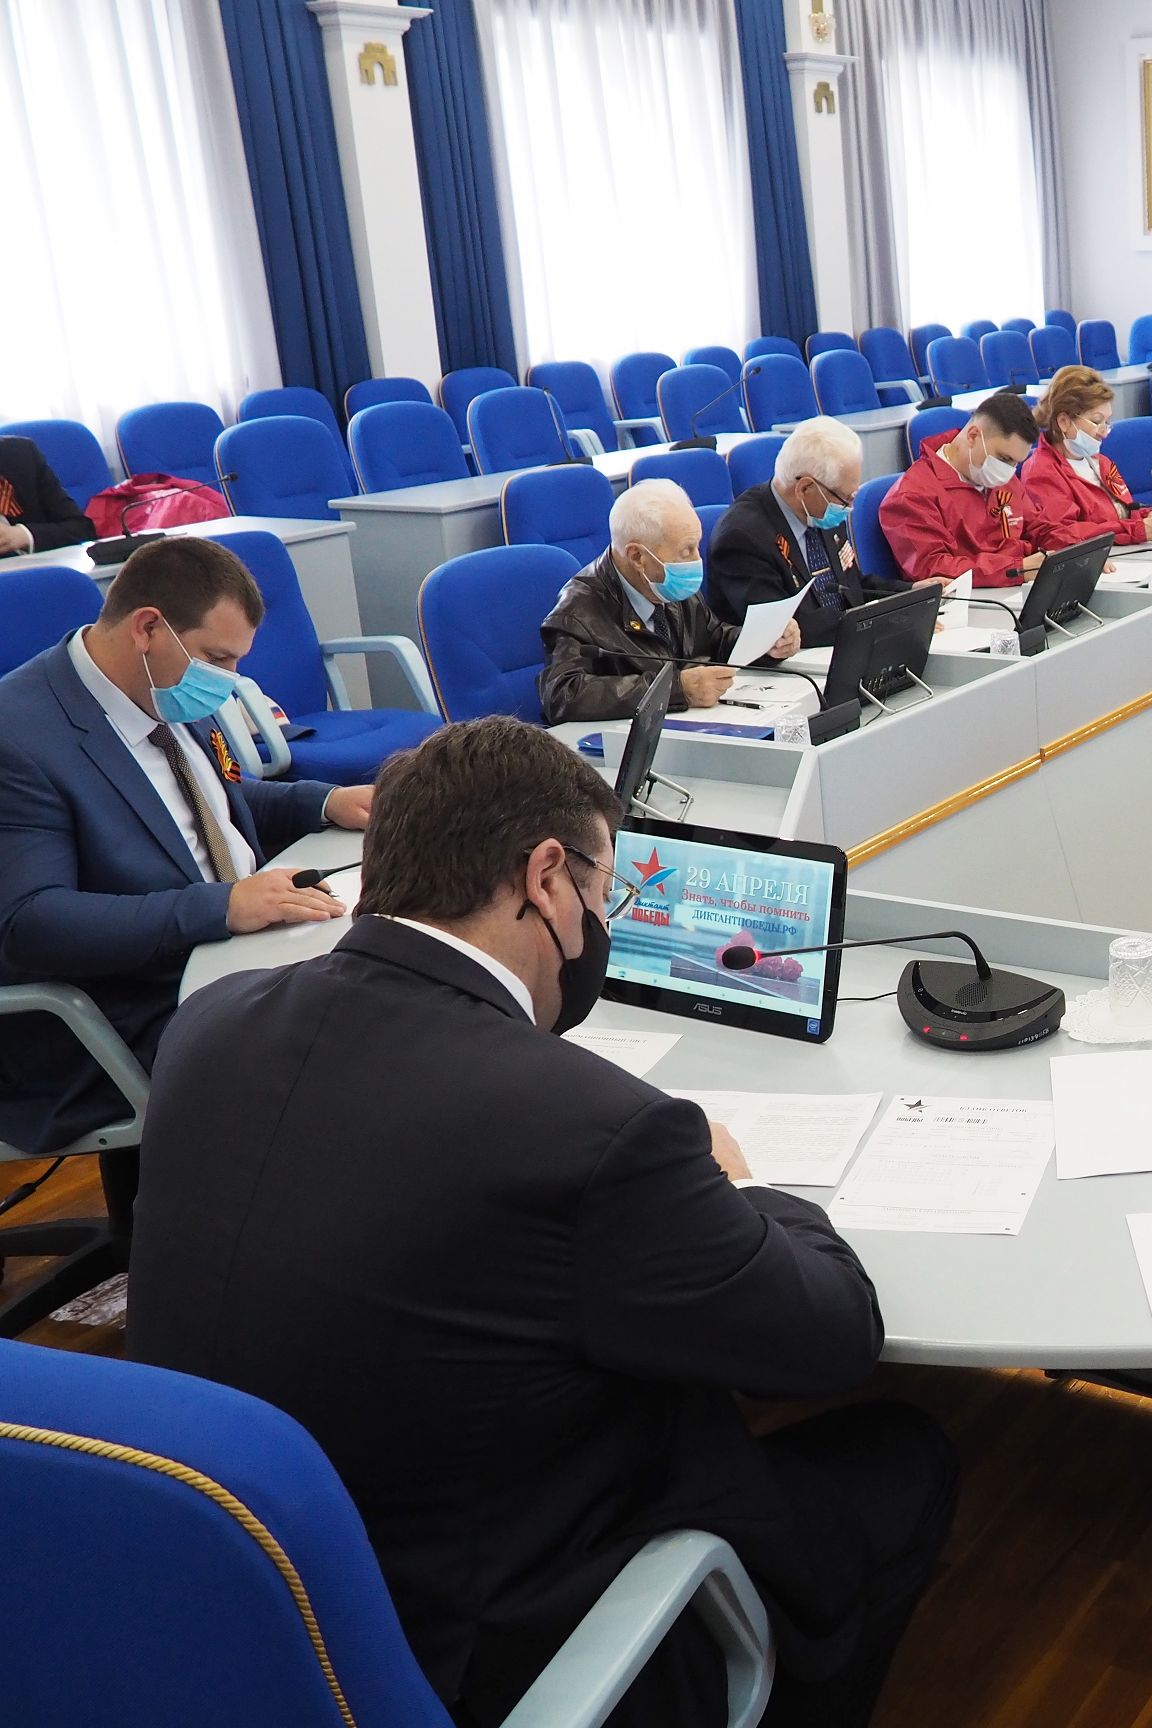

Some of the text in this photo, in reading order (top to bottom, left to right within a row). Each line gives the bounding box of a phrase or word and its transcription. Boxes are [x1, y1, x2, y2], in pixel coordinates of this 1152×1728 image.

[686, 866, 810, 905] 29 АПРЕЛЯ
[632, 907, 670, 926] ПОБЕДЫ
[681, 888, 811, 922] Знать, чтобы помнить
[692, 909, 797, 936] ДИКТАНТПОБЕДЫ.РФ
[693, 1002, 723, 1016] ASUS
